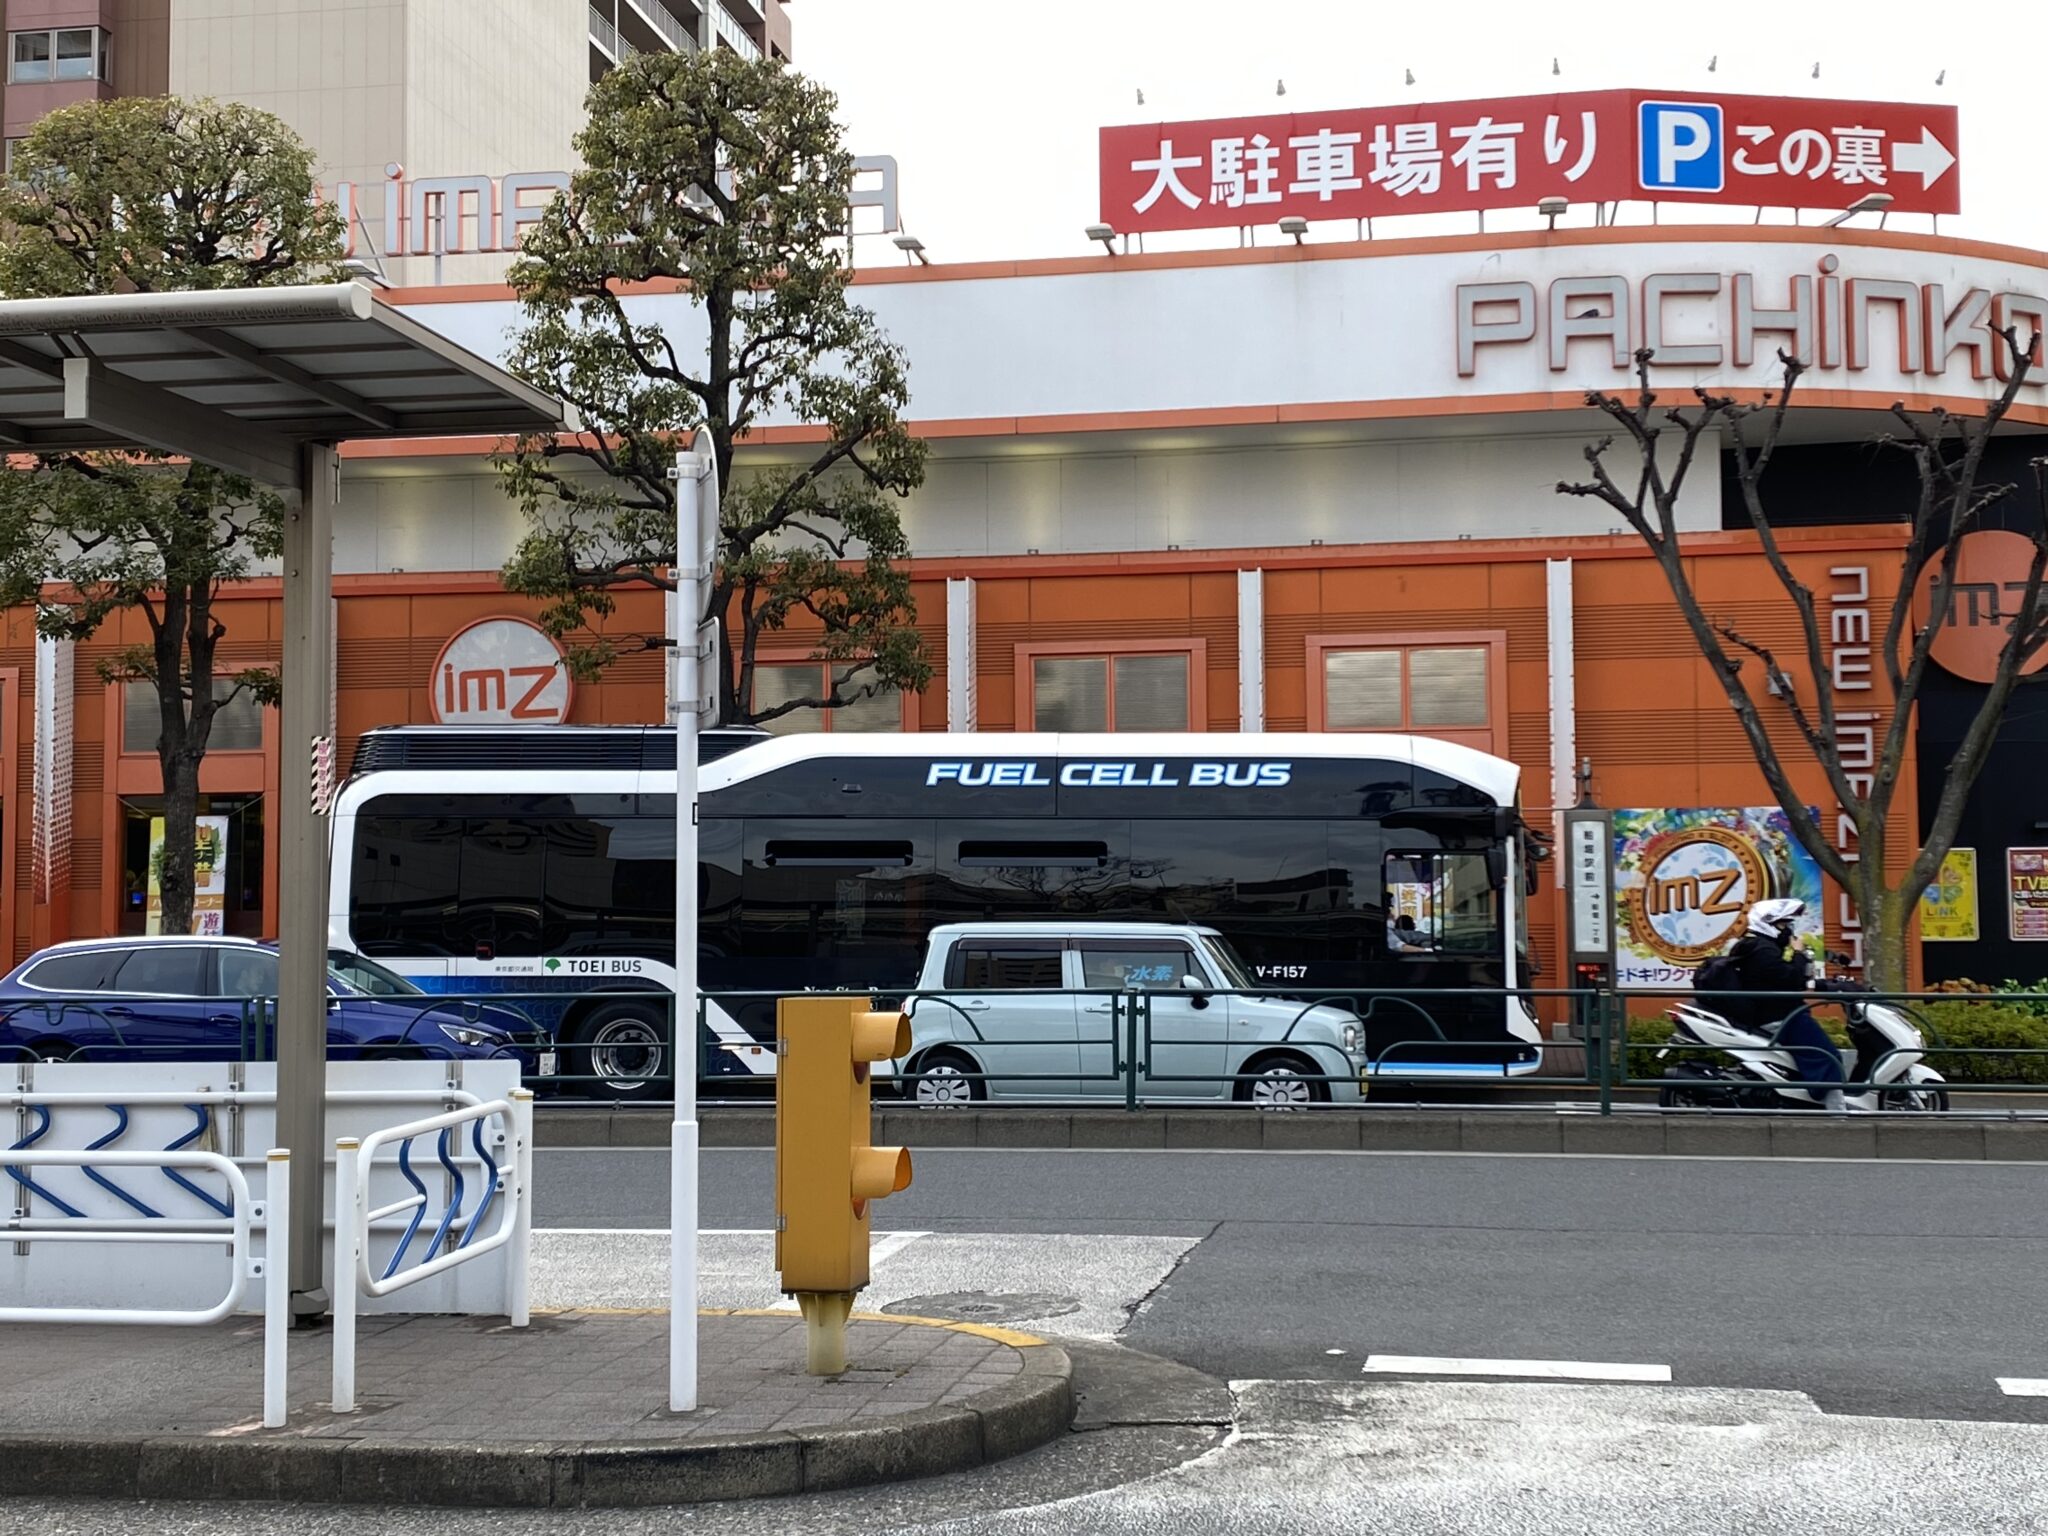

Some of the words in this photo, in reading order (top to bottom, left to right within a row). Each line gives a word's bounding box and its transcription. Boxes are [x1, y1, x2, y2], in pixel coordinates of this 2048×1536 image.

[1130, 110, 1598, 214] 大駐車場有り
[1657, 110, 1712, 183] P
[1731, 125, 1889, 186] この裏
[925, 761, 1051, 787] FUEL
[1059, 761, 1180, 787] CELL
[1187, 761, 1292, 787] BUS
[568, 960, 605, 973] TOEI
[611, 960, 642, 973] BUS
[1130, 965, 1174, 981] 水素
[1255, 965, 1308, 979] V-F157
